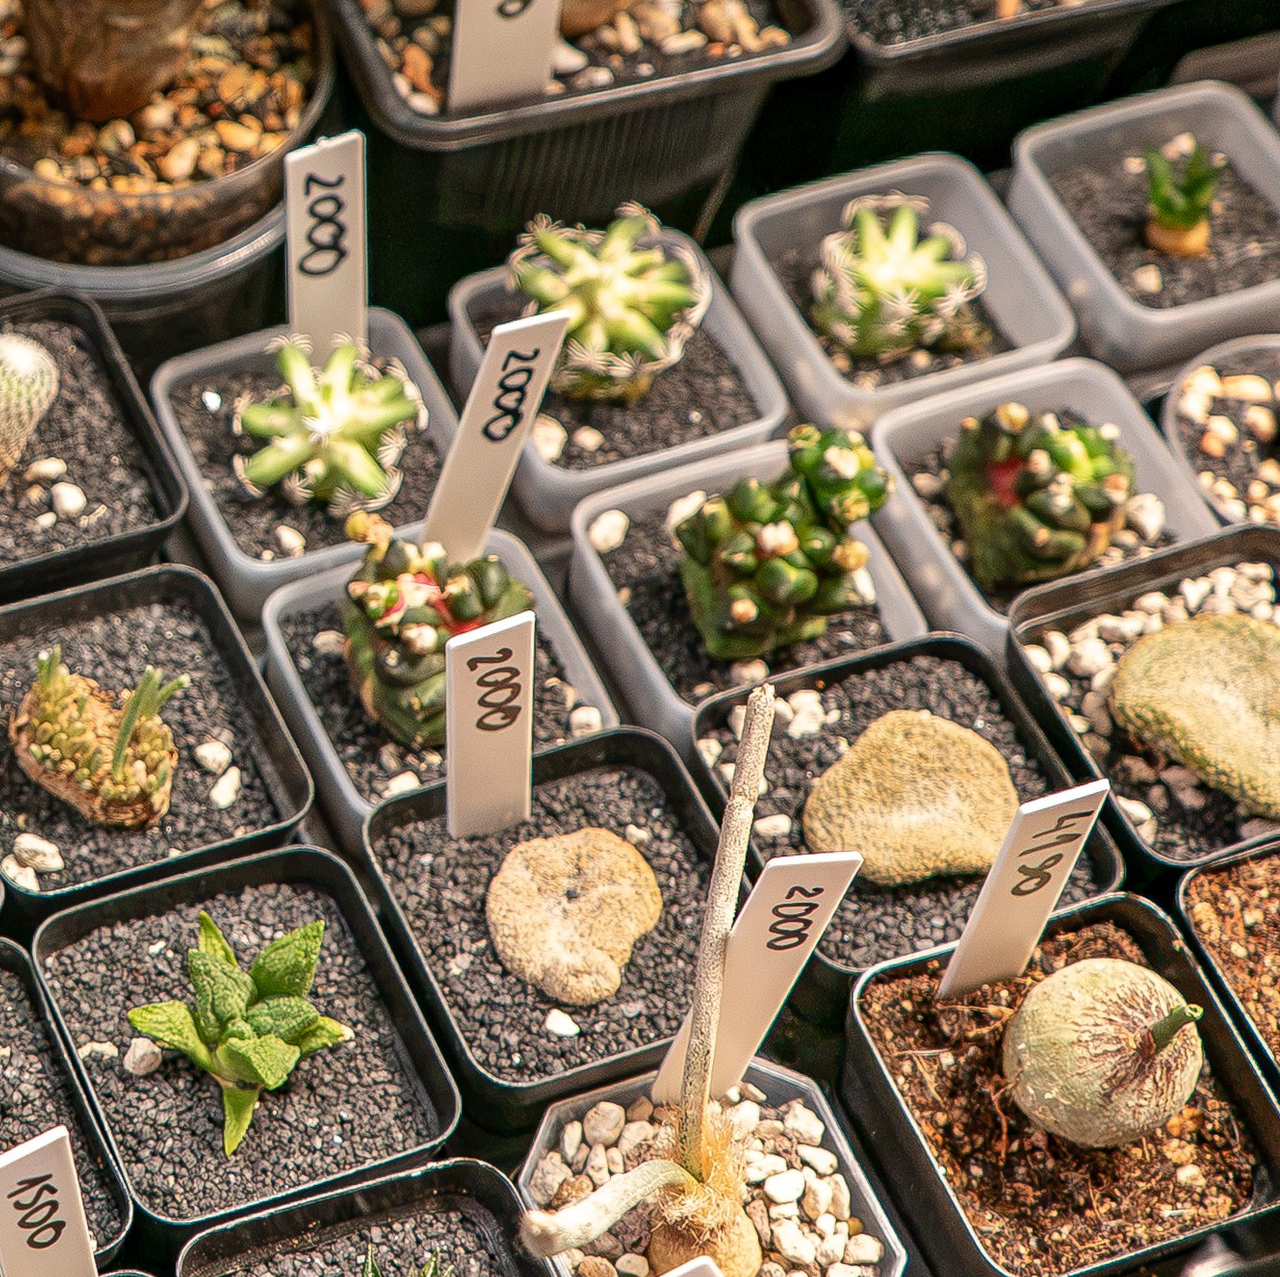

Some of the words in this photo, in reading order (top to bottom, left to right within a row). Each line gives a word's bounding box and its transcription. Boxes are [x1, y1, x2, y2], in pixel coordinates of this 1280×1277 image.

[298, 173, 347, 276] 2000
[482, 348, 540, 442] 2000
[466, 647, 522, 732] 2000
[1010, 810, 1095, 896] 4190
[766, 885, 825, 951] 2000
[6, 1173, 67, 1250] 1500
